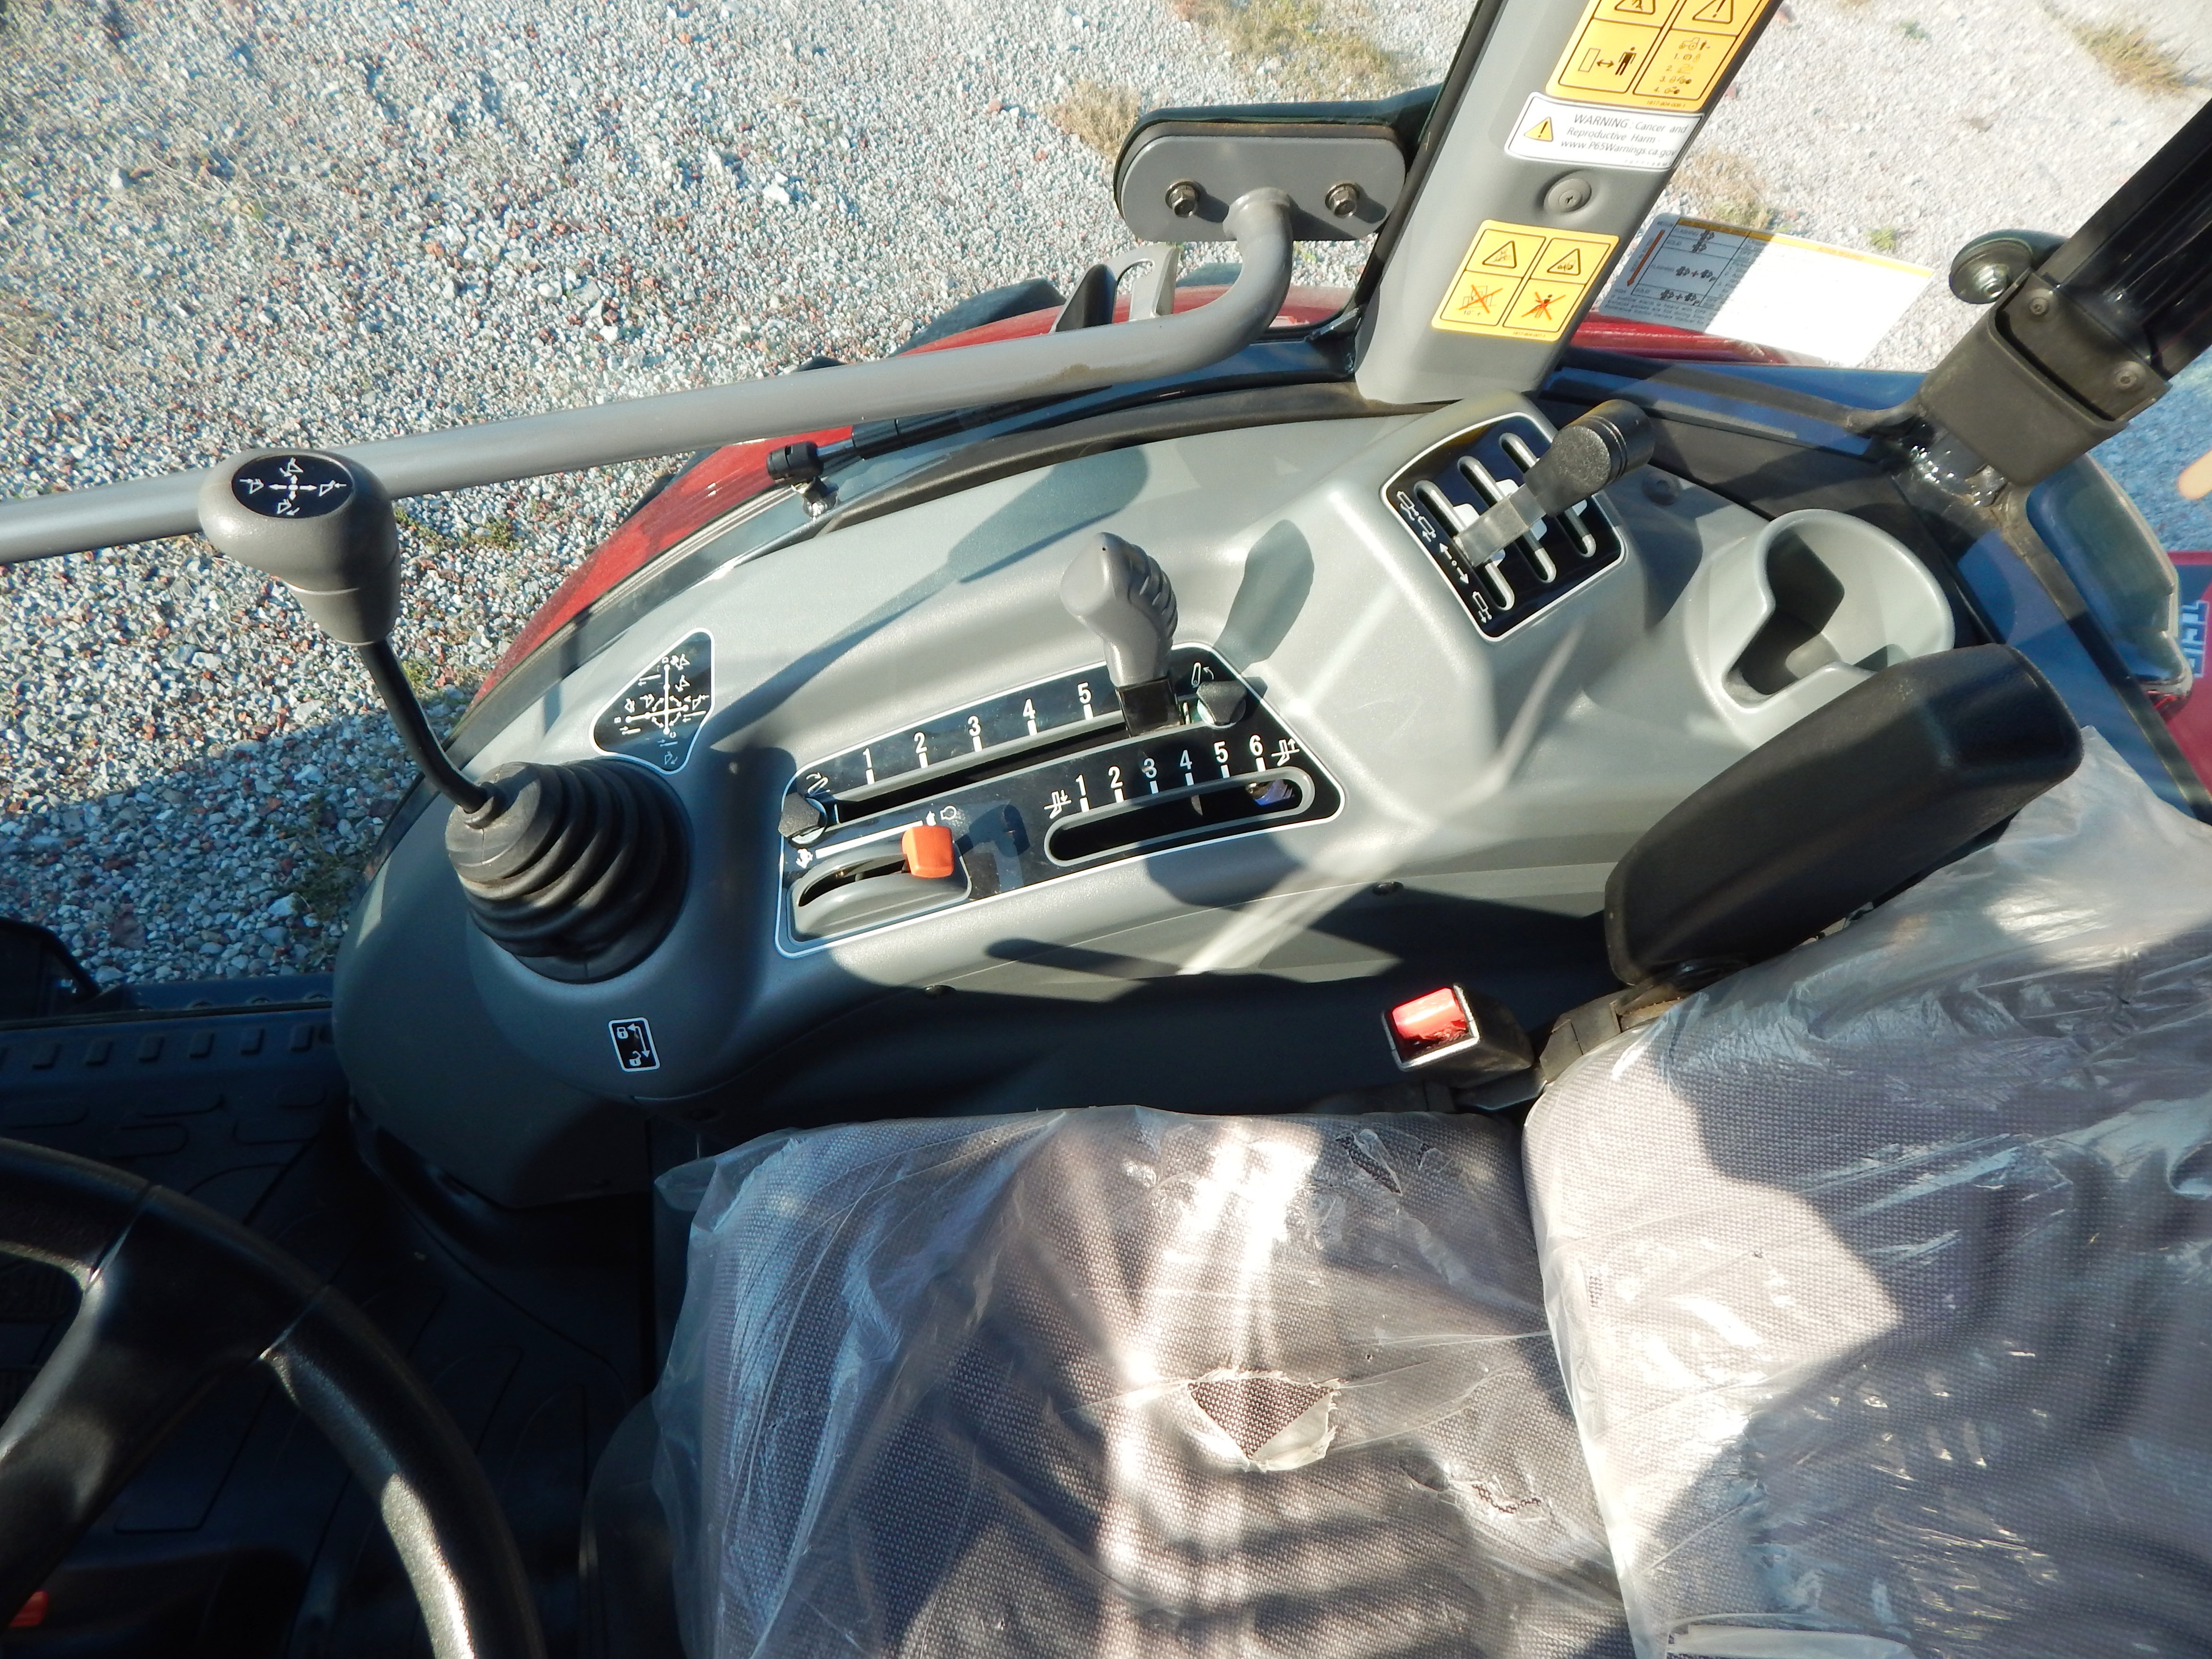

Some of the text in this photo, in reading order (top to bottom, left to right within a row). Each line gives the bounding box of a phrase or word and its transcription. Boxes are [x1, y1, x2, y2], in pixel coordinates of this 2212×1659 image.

[1567, 127, 1627, 141] Reproductive
[1631, 133, 1656, 144] Harm
[1635, 121, 1666, 132] Cancer
[1669, 124, 1689, 133] and
[1561, 141, 1677, 158] www.P65Warnings.ca.gov
[863, 682, 1092, 768] 1 2 3 4 5
[1075, 734, 1263, 796] 1 2 3 4 5 6
